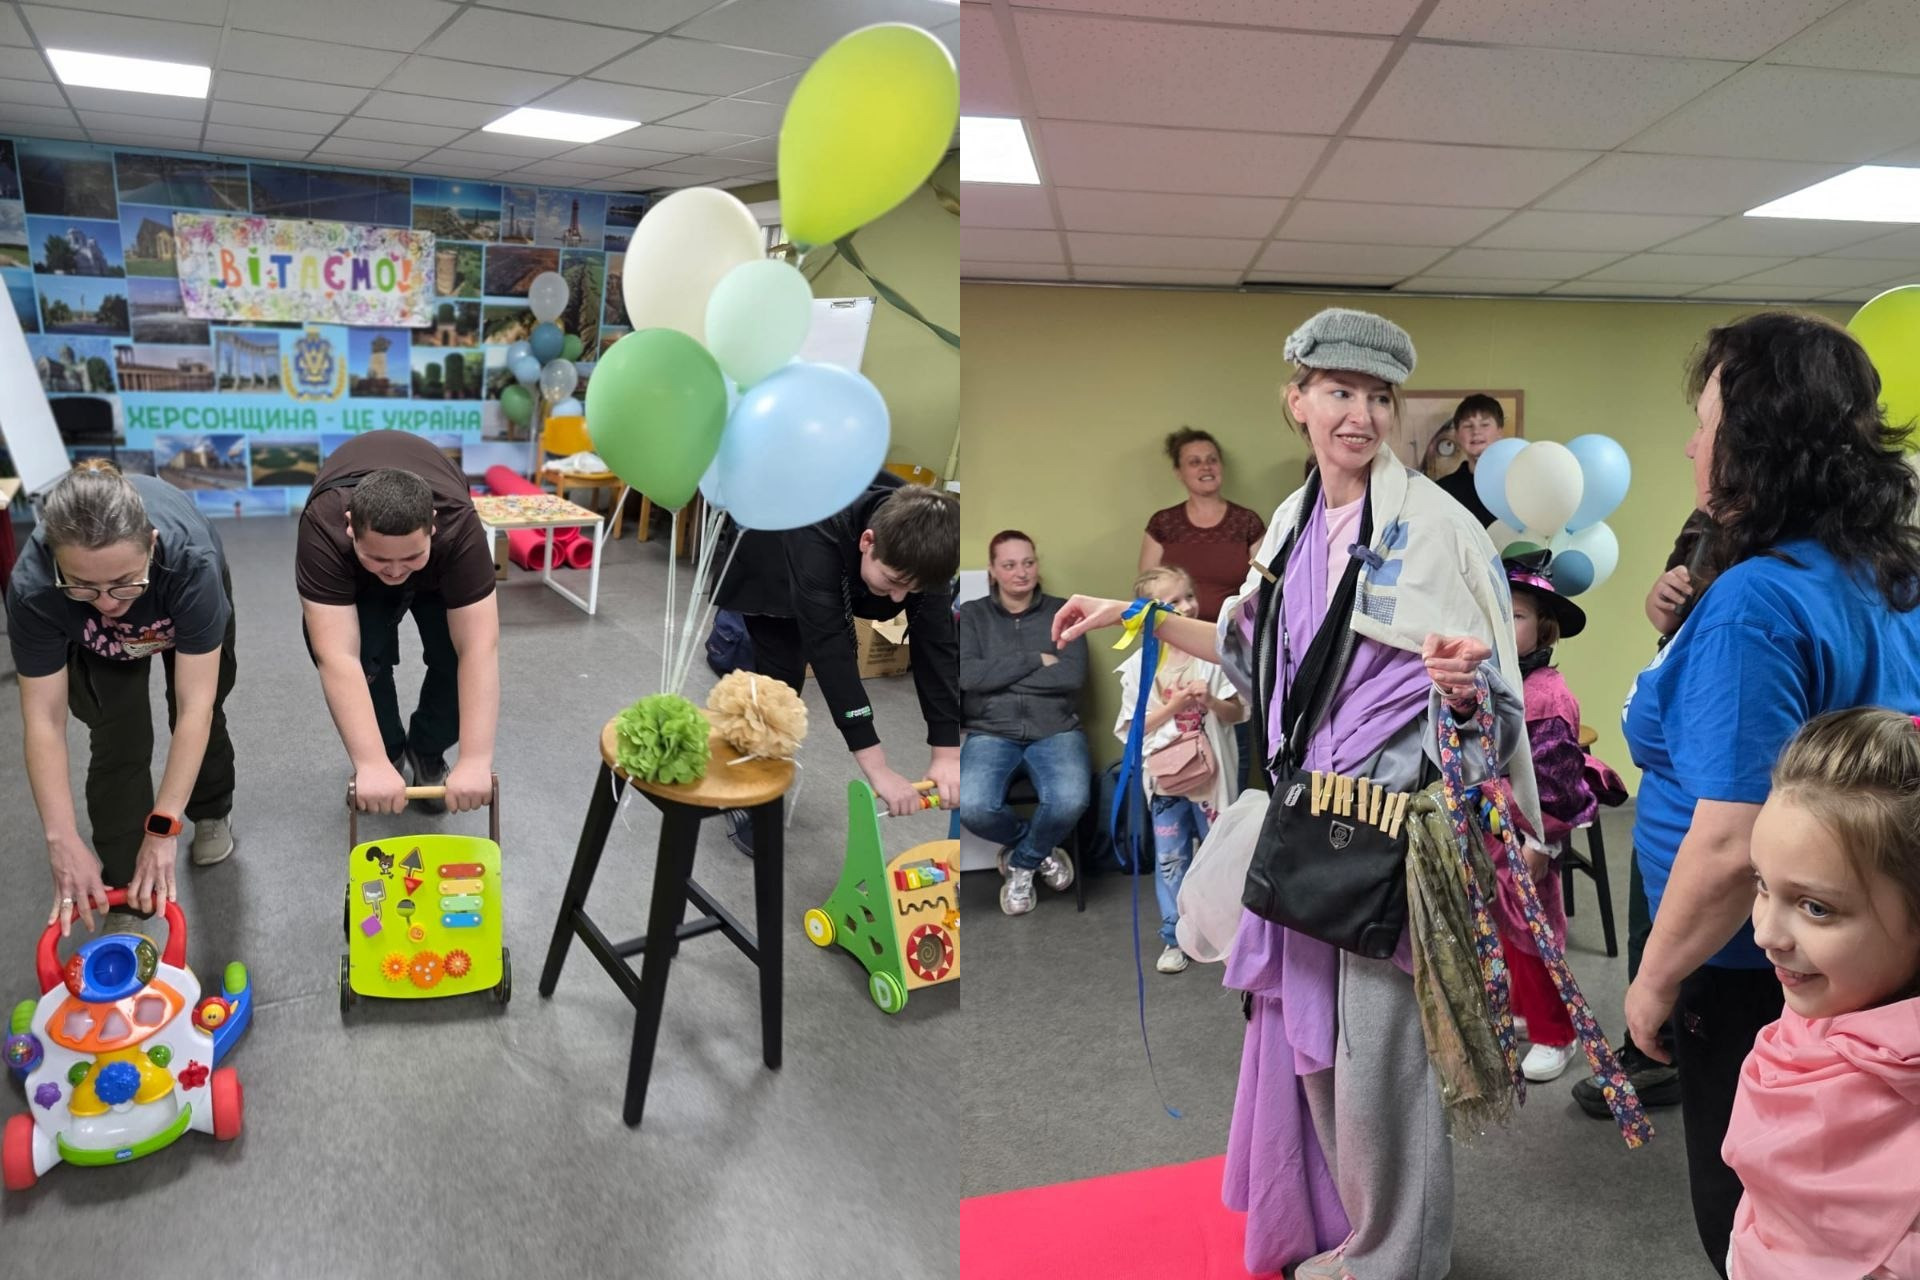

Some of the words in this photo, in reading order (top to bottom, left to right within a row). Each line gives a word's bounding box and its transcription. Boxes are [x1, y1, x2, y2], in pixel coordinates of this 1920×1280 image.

[127, 405, 317, 432] ХЕРСОНЩИНА
[341, 408, 374, 432] ЦЕ
[381, 405, 482, 431] УКРАЇНА
